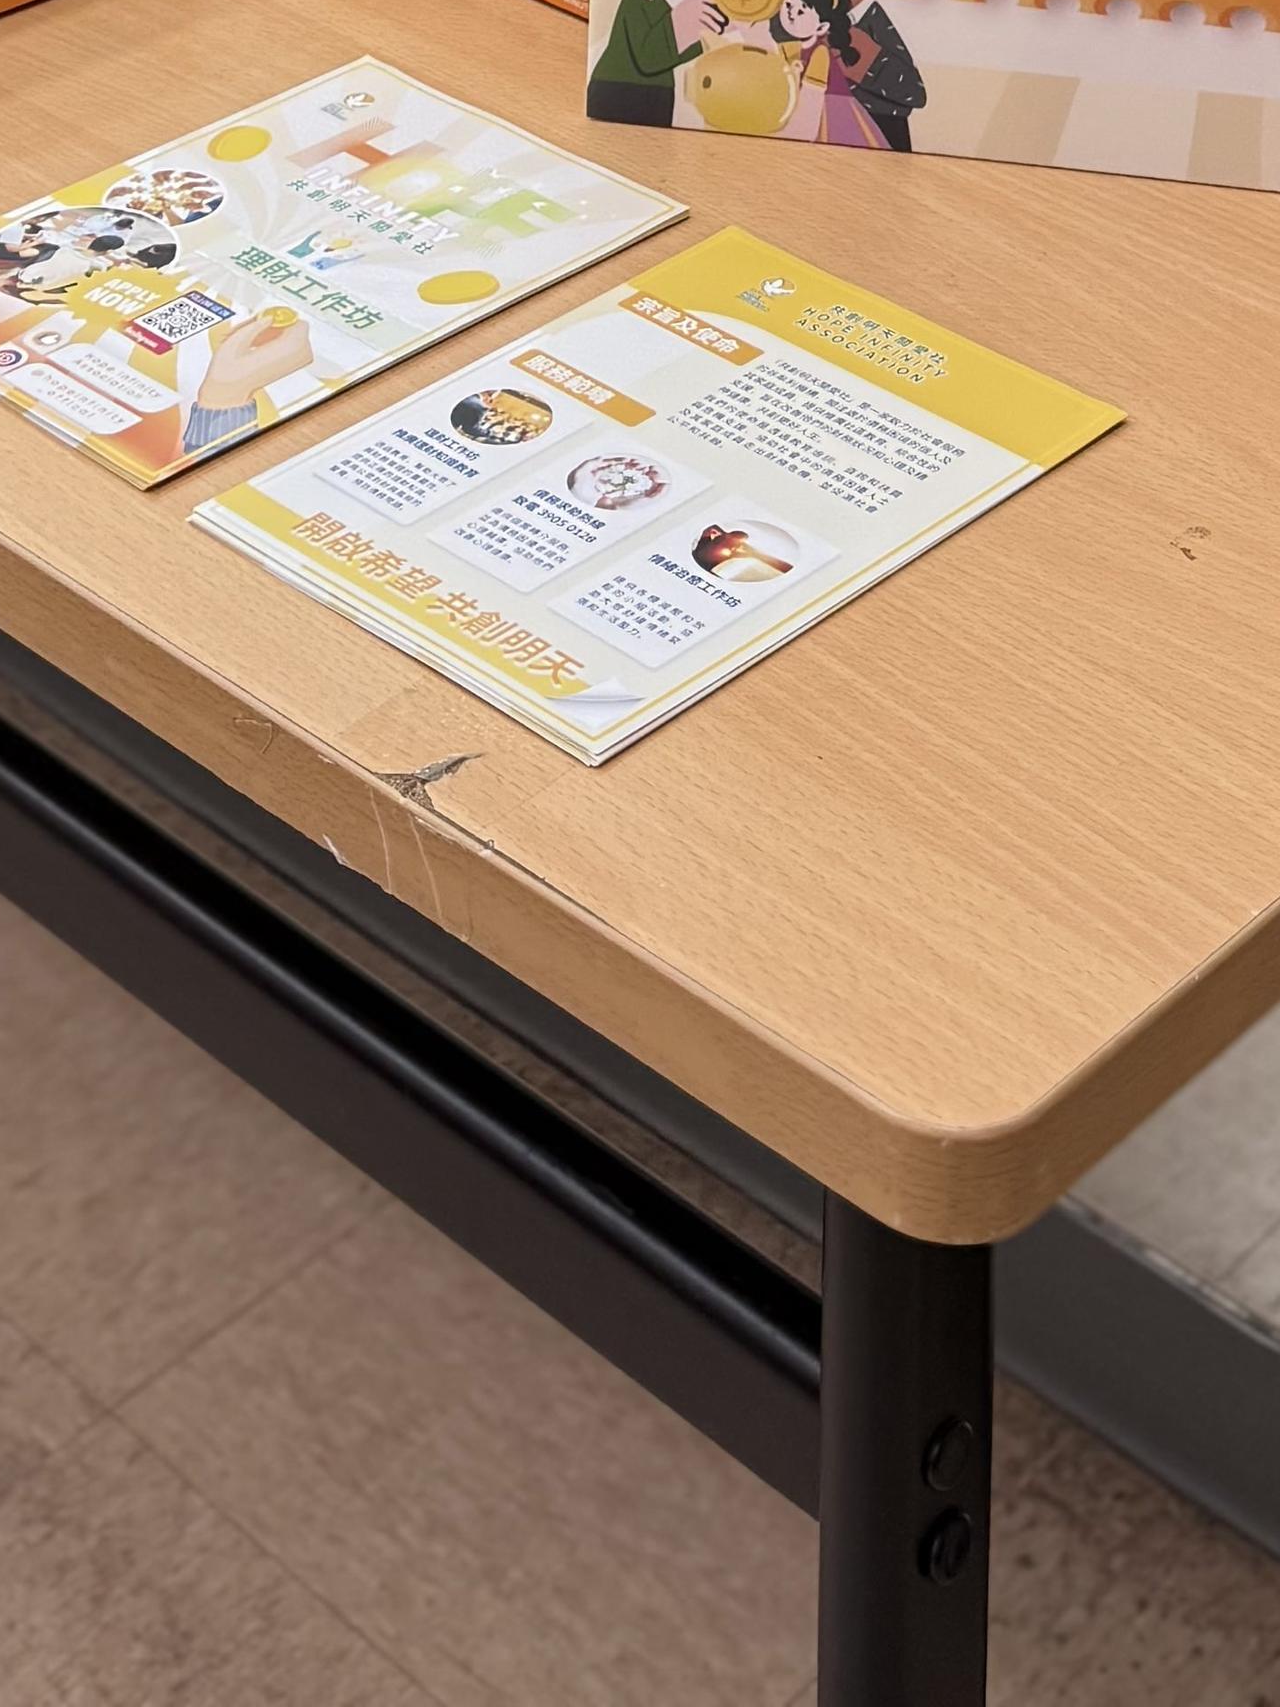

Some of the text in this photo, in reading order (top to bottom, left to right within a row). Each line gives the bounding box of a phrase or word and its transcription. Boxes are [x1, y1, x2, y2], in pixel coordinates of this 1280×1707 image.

[83, 289, 144, 314] NOW
[104, 280, 160, 301] APPLY
[225, 247, 387, 330] 理財工作坊
[629, 298, 744, 352] 宗旨及使命
[793, 320, 926, 381] ASSOCIATION
[802, 309, 947, 376] HOPE INFINITY
[535, 508, 570, 527] 3905
[290, 512, 441, 598] 開啟希望
[424, 590, 588, 685] 共創明天
